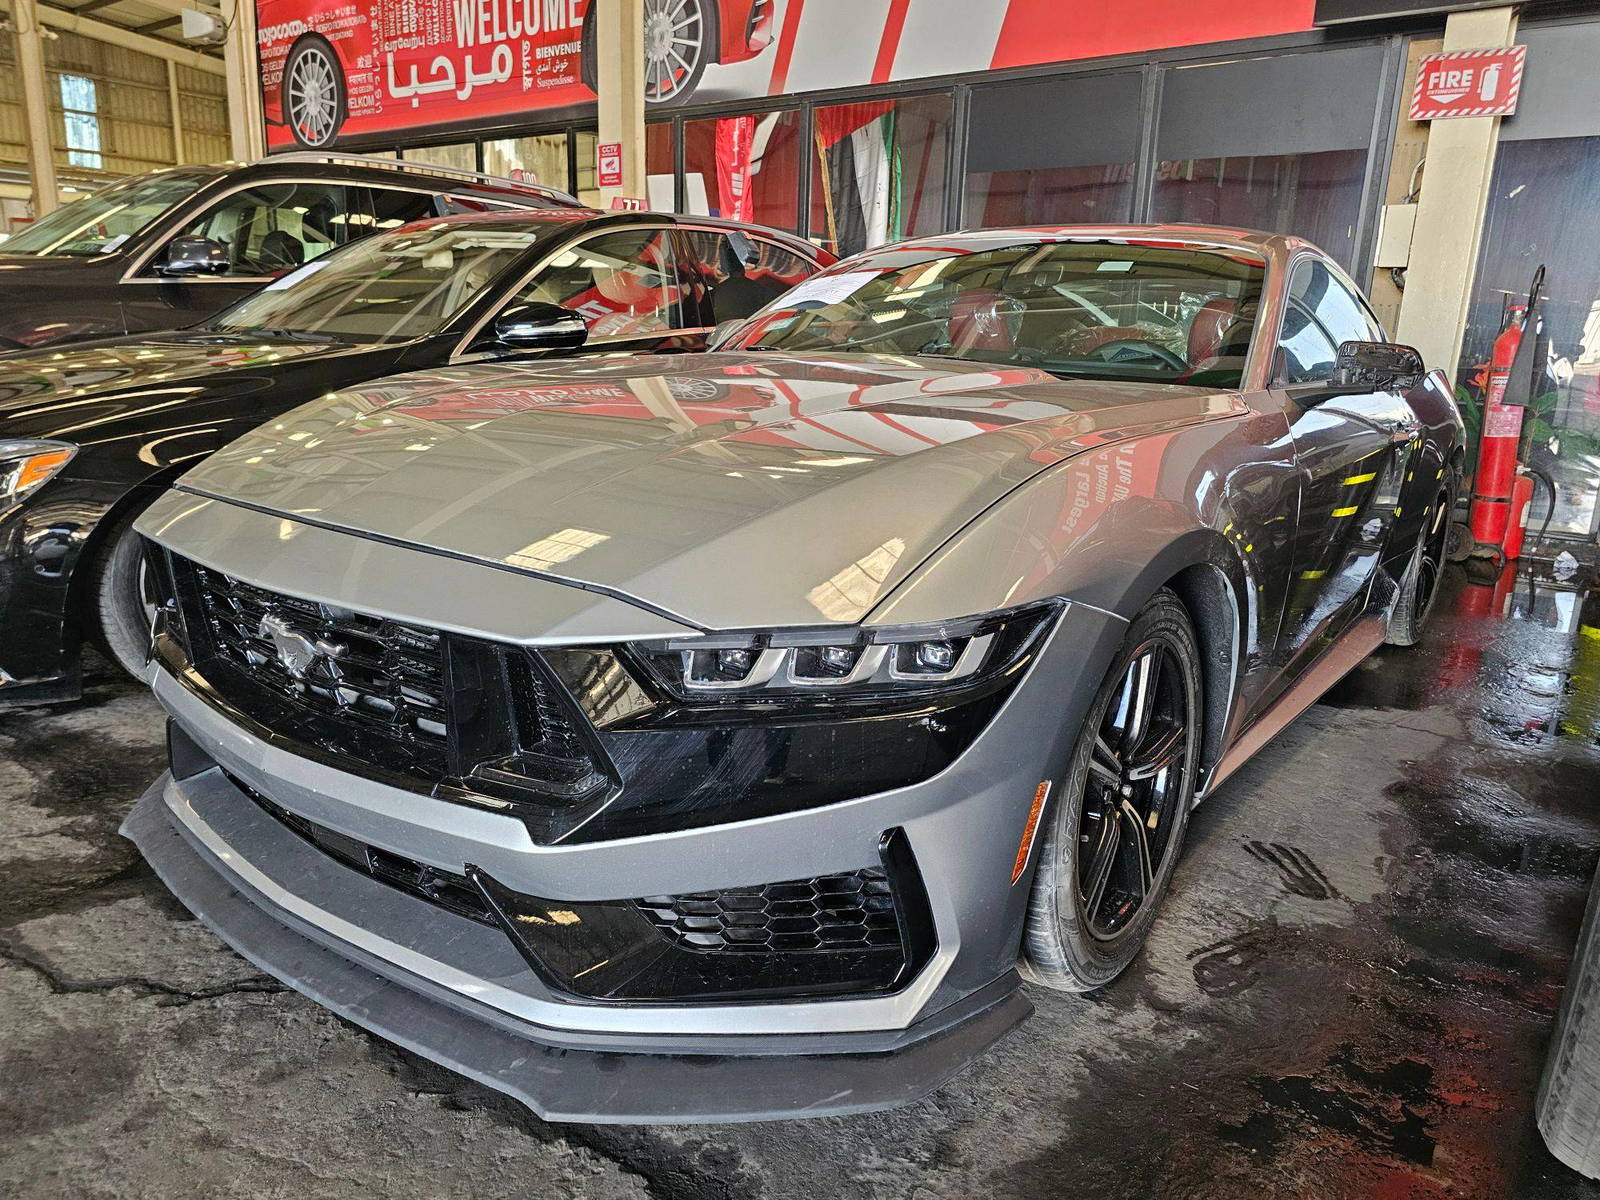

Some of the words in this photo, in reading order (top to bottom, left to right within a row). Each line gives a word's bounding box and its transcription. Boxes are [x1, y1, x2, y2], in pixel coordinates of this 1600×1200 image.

[453, 0, 585, 49] WELCOME
[536, 41, 582, 59] BIENVENUE
[387, 44, 514, 108] مرحبا
[1428, 69, 1474, 89] FIRE
